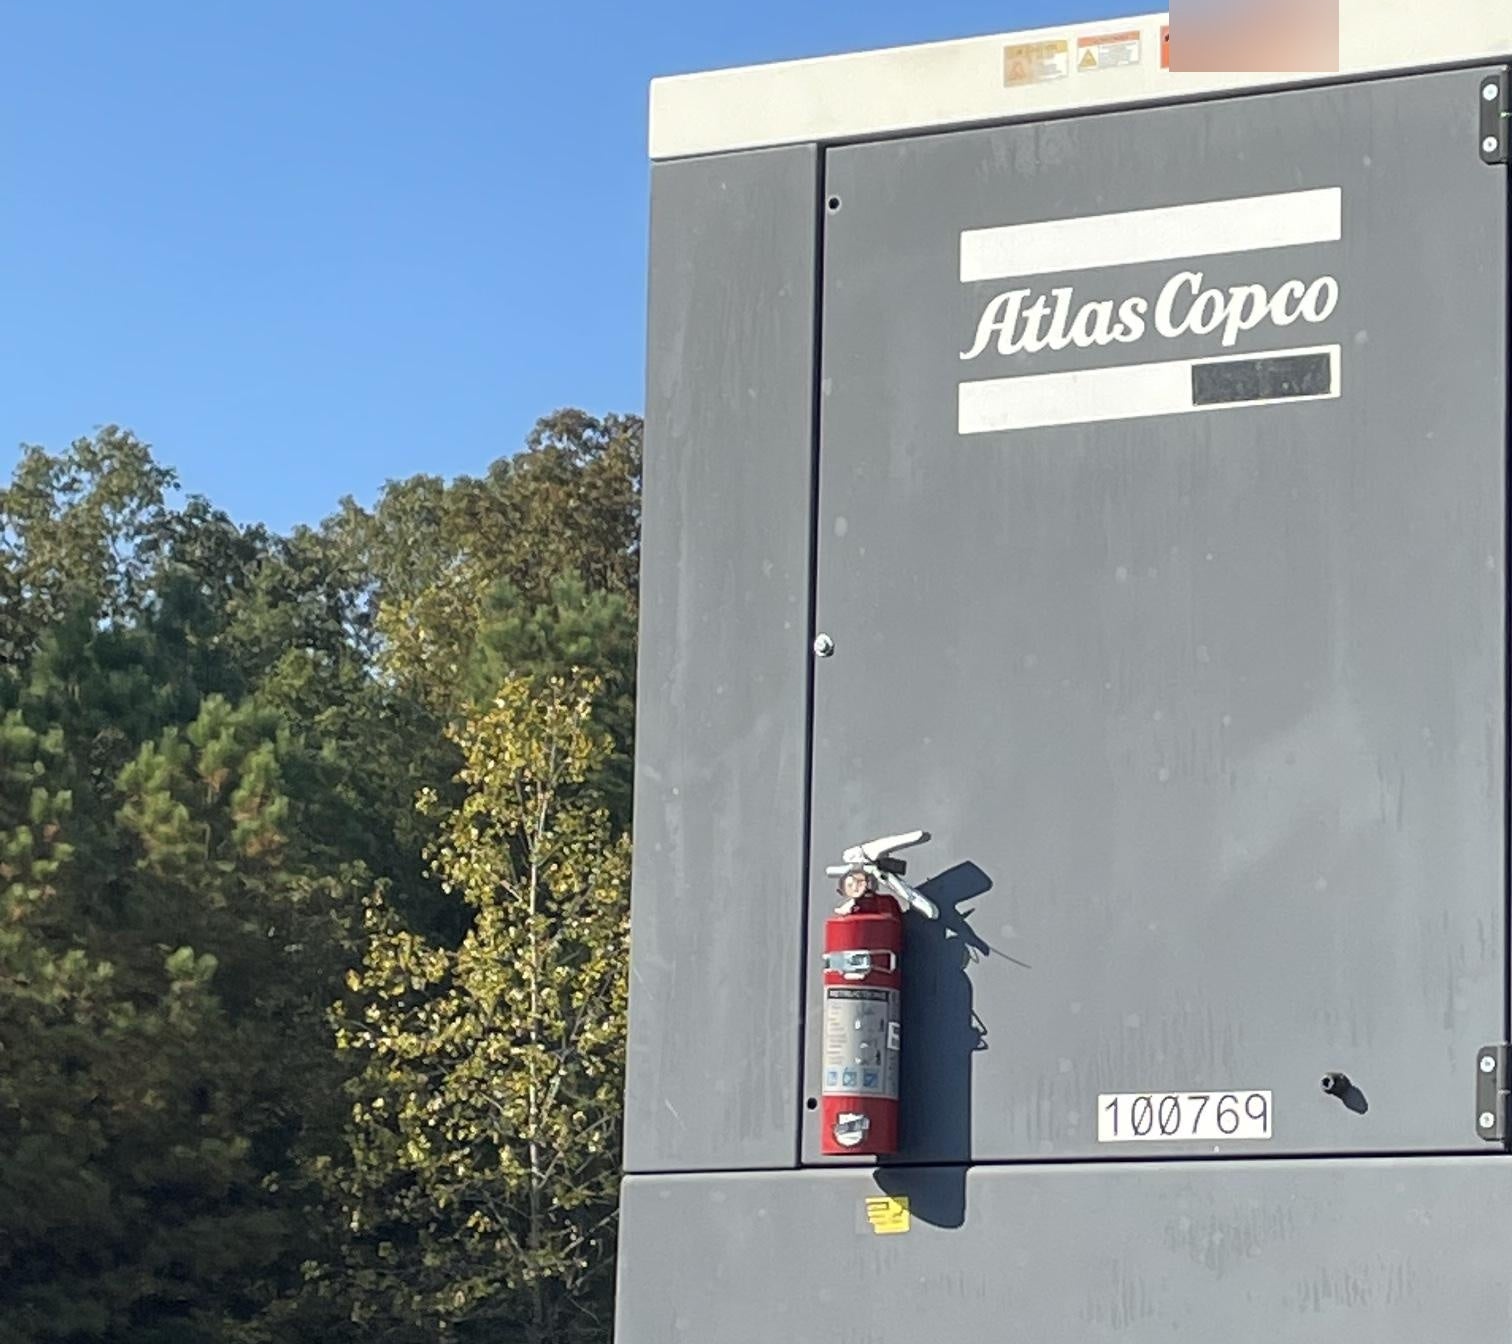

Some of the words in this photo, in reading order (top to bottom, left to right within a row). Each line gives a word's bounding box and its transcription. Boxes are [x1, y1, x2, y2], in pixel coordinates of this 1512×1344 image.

[960, 286, 1148, 360] Atlas
[1154, 271, 1339, 346] Copco
[1105, 1093, 1268, 1137] 100769
